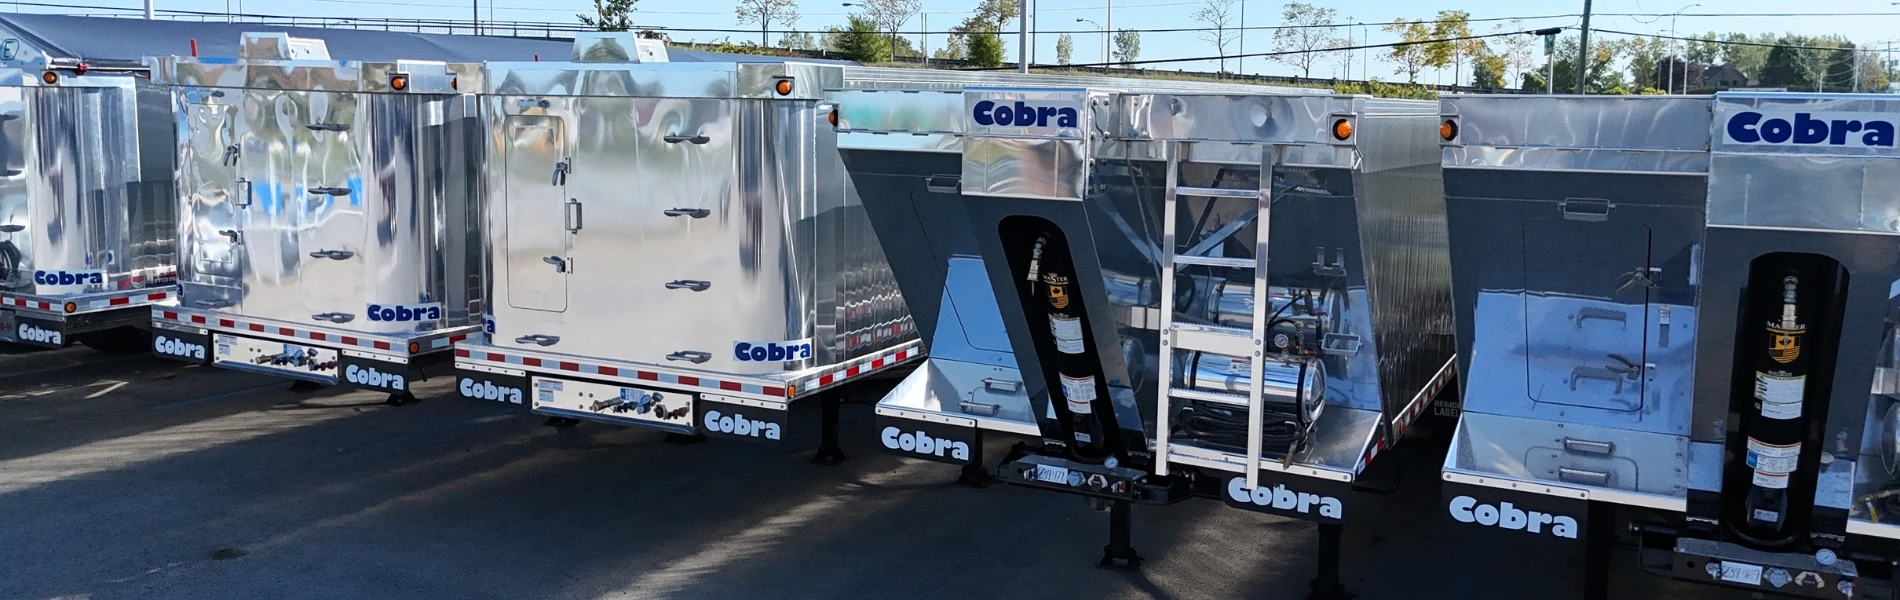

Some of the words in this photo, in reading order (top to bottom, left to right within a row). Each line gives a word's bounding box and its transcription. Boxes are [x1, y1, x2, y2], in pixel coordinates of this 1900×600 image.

[973, 100, 1078, 128] Cobra
[1727, 111, 1895, 147] Cobra
[34, 270, 103, 286] Cobra
[367, 304, 440, 322] Cobra
[1766, 320, 1806, 330] MAER
[18, 323, 62, 345] Cobra
[154, 335, 206, 360] Cobra
[734, 342, 811, 362] Cobra
[345, 364, 404, 390] Cobra
[459, 377, 523, 405] Cobra
[704, 410, 781, 440] Cobra
[881, 426, 969, 461] Cobra
[1227, 476, 1342, 519] Cobra
[1449, 495, 1578, 539] Cobra
